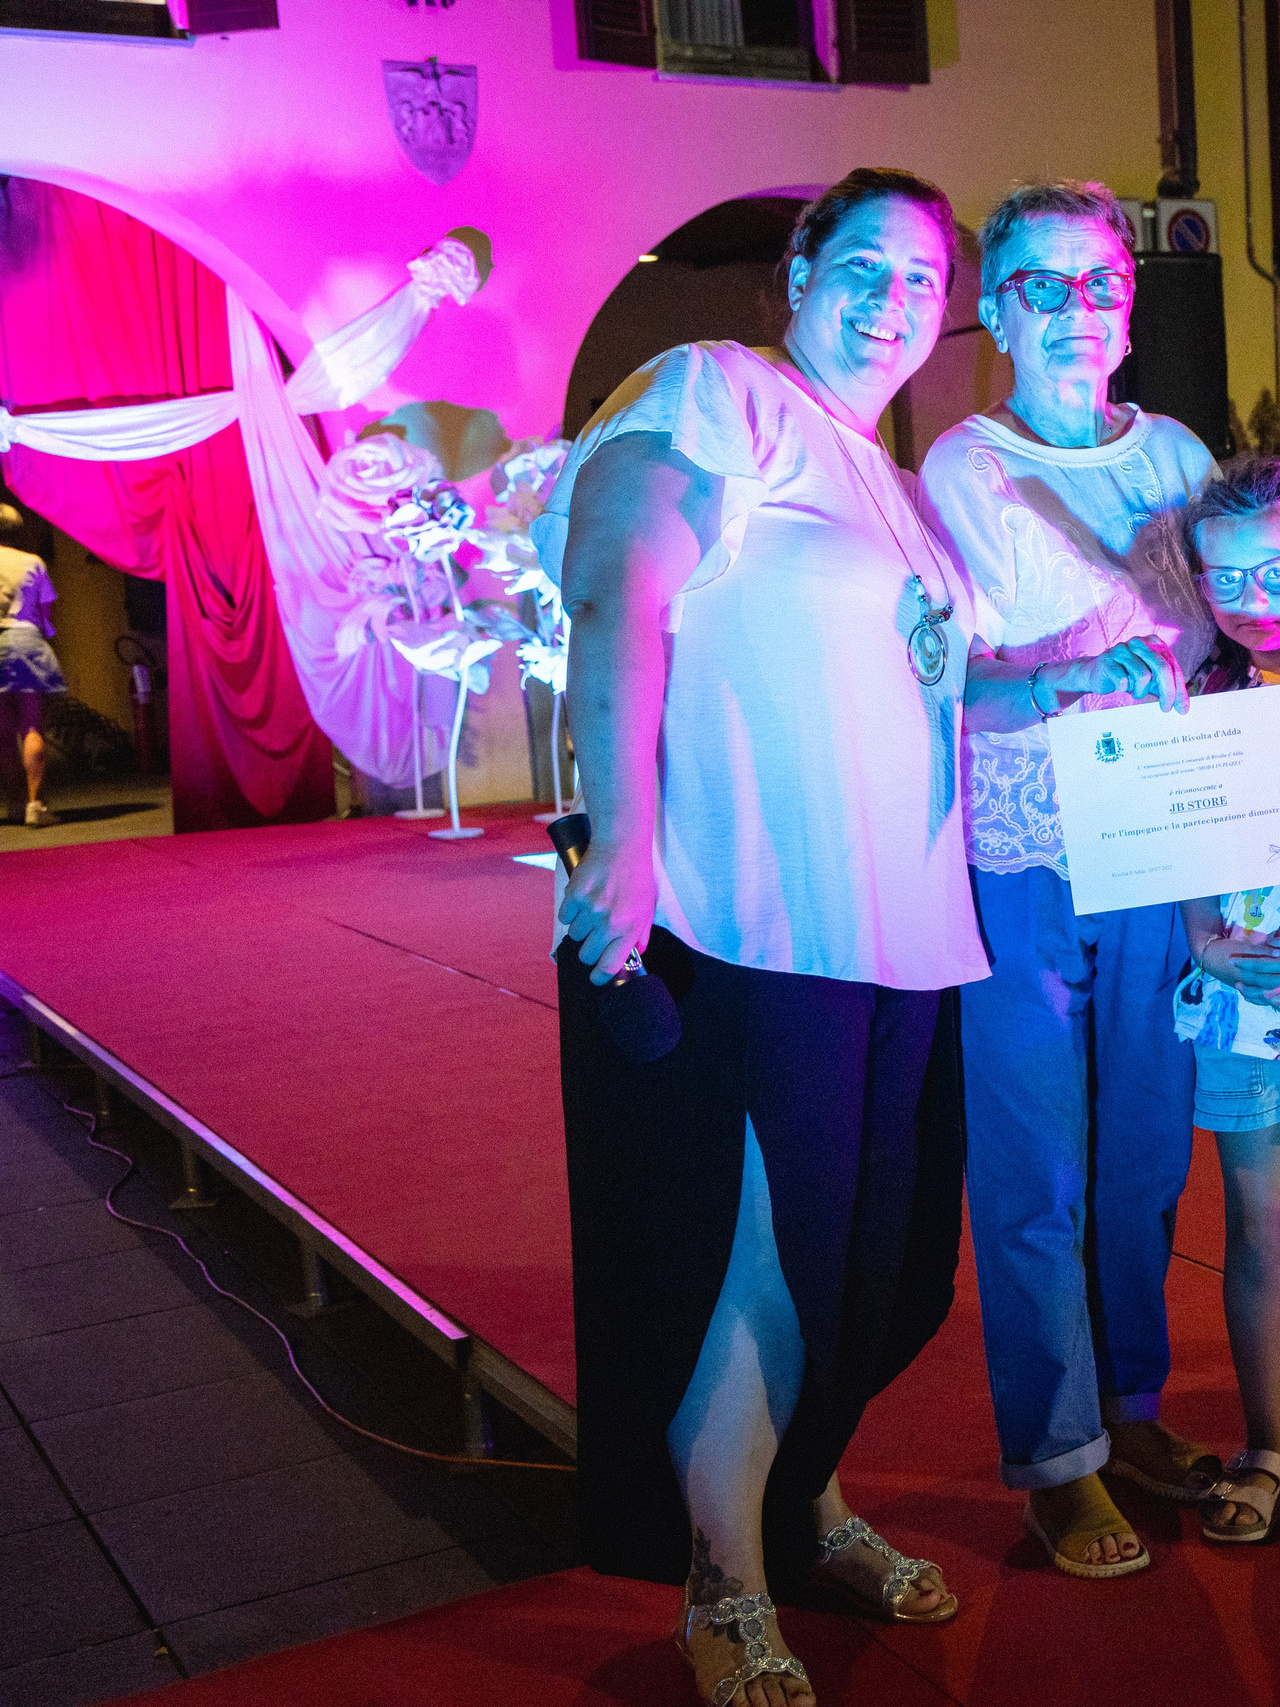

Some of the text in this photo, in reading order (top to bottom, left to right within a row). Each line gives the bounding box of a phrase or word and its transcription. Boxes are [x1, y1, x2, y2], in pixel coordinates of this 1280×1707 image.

[1134, 740, 1169, 749] Comune
[1182, 733, 1211, 743] Rivolta
[1213, 728, 1241, 738] d'Adda
[1175, 784, 1217, 795] riconoscente
[1169, 795, 1228, 812] JB STORE
[1119, 826, 1162, 837] l'impegno
[1183, 812, 1246, 829] partecipazione
